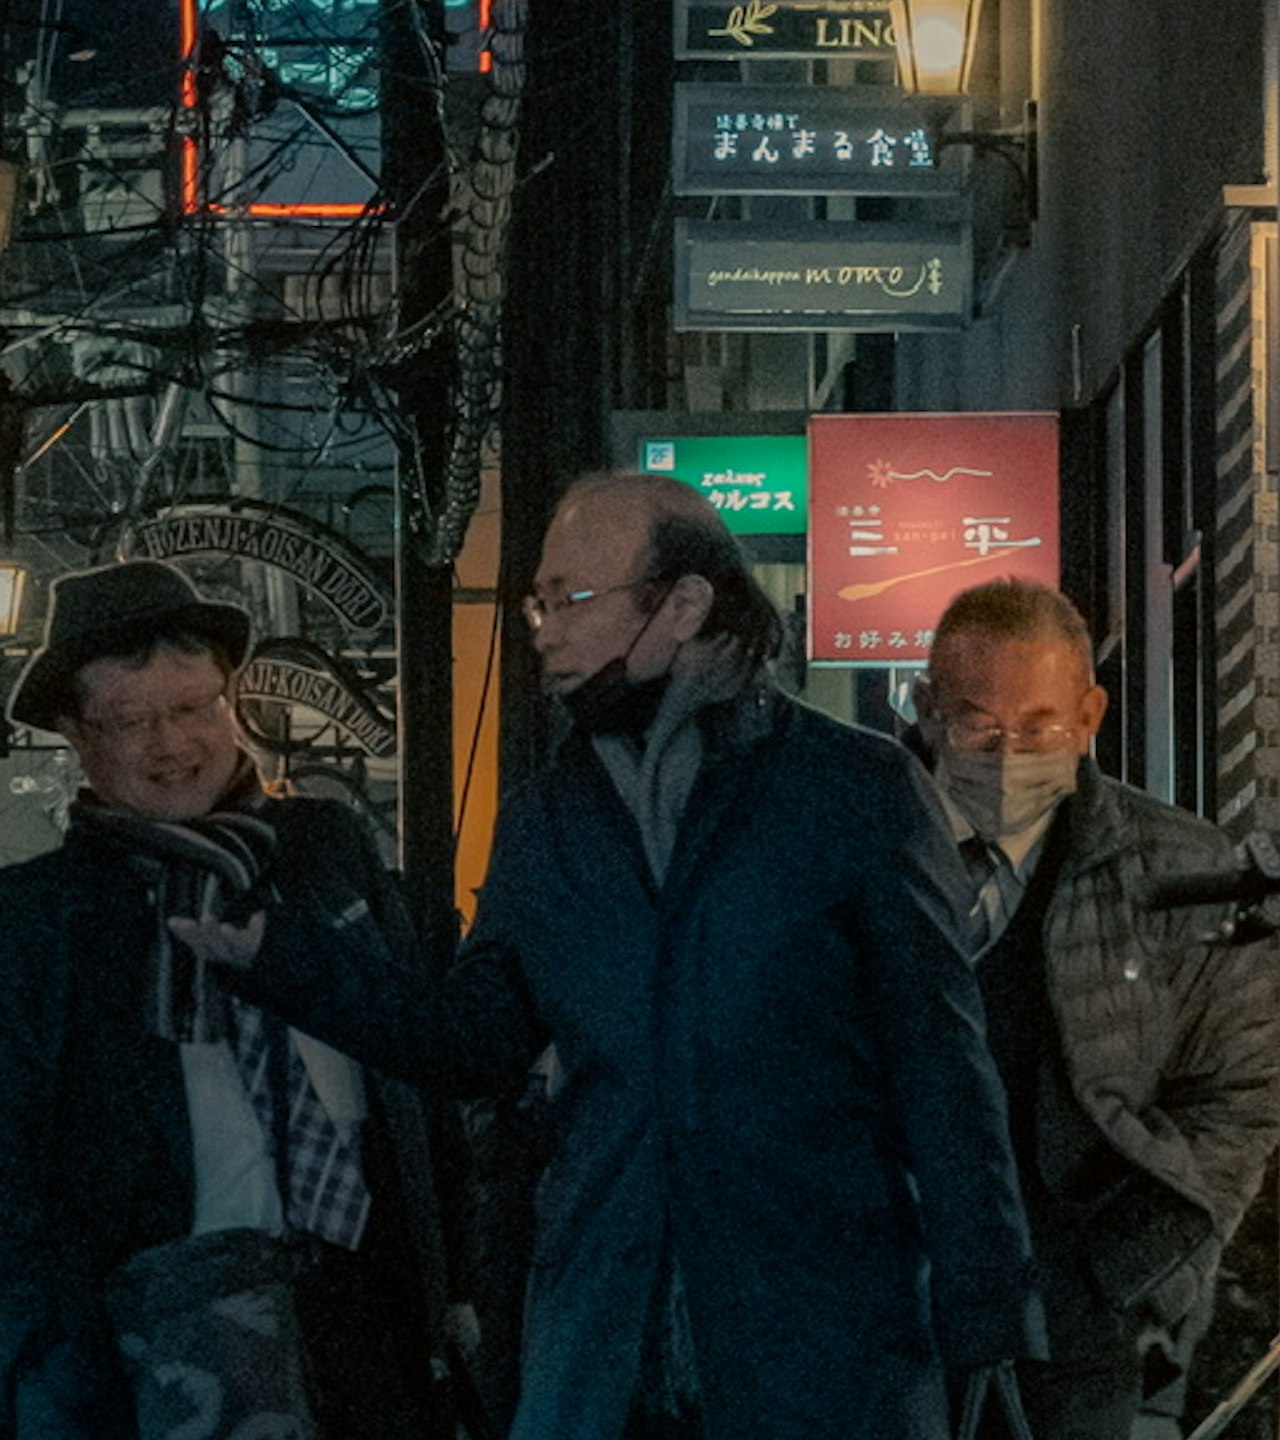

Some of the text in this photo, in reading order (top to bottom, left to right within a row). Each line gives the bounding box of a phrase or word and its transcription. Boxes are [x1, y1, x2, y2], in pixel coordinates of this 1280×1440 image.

[712, 127, 935, 167] まんまる食堂
